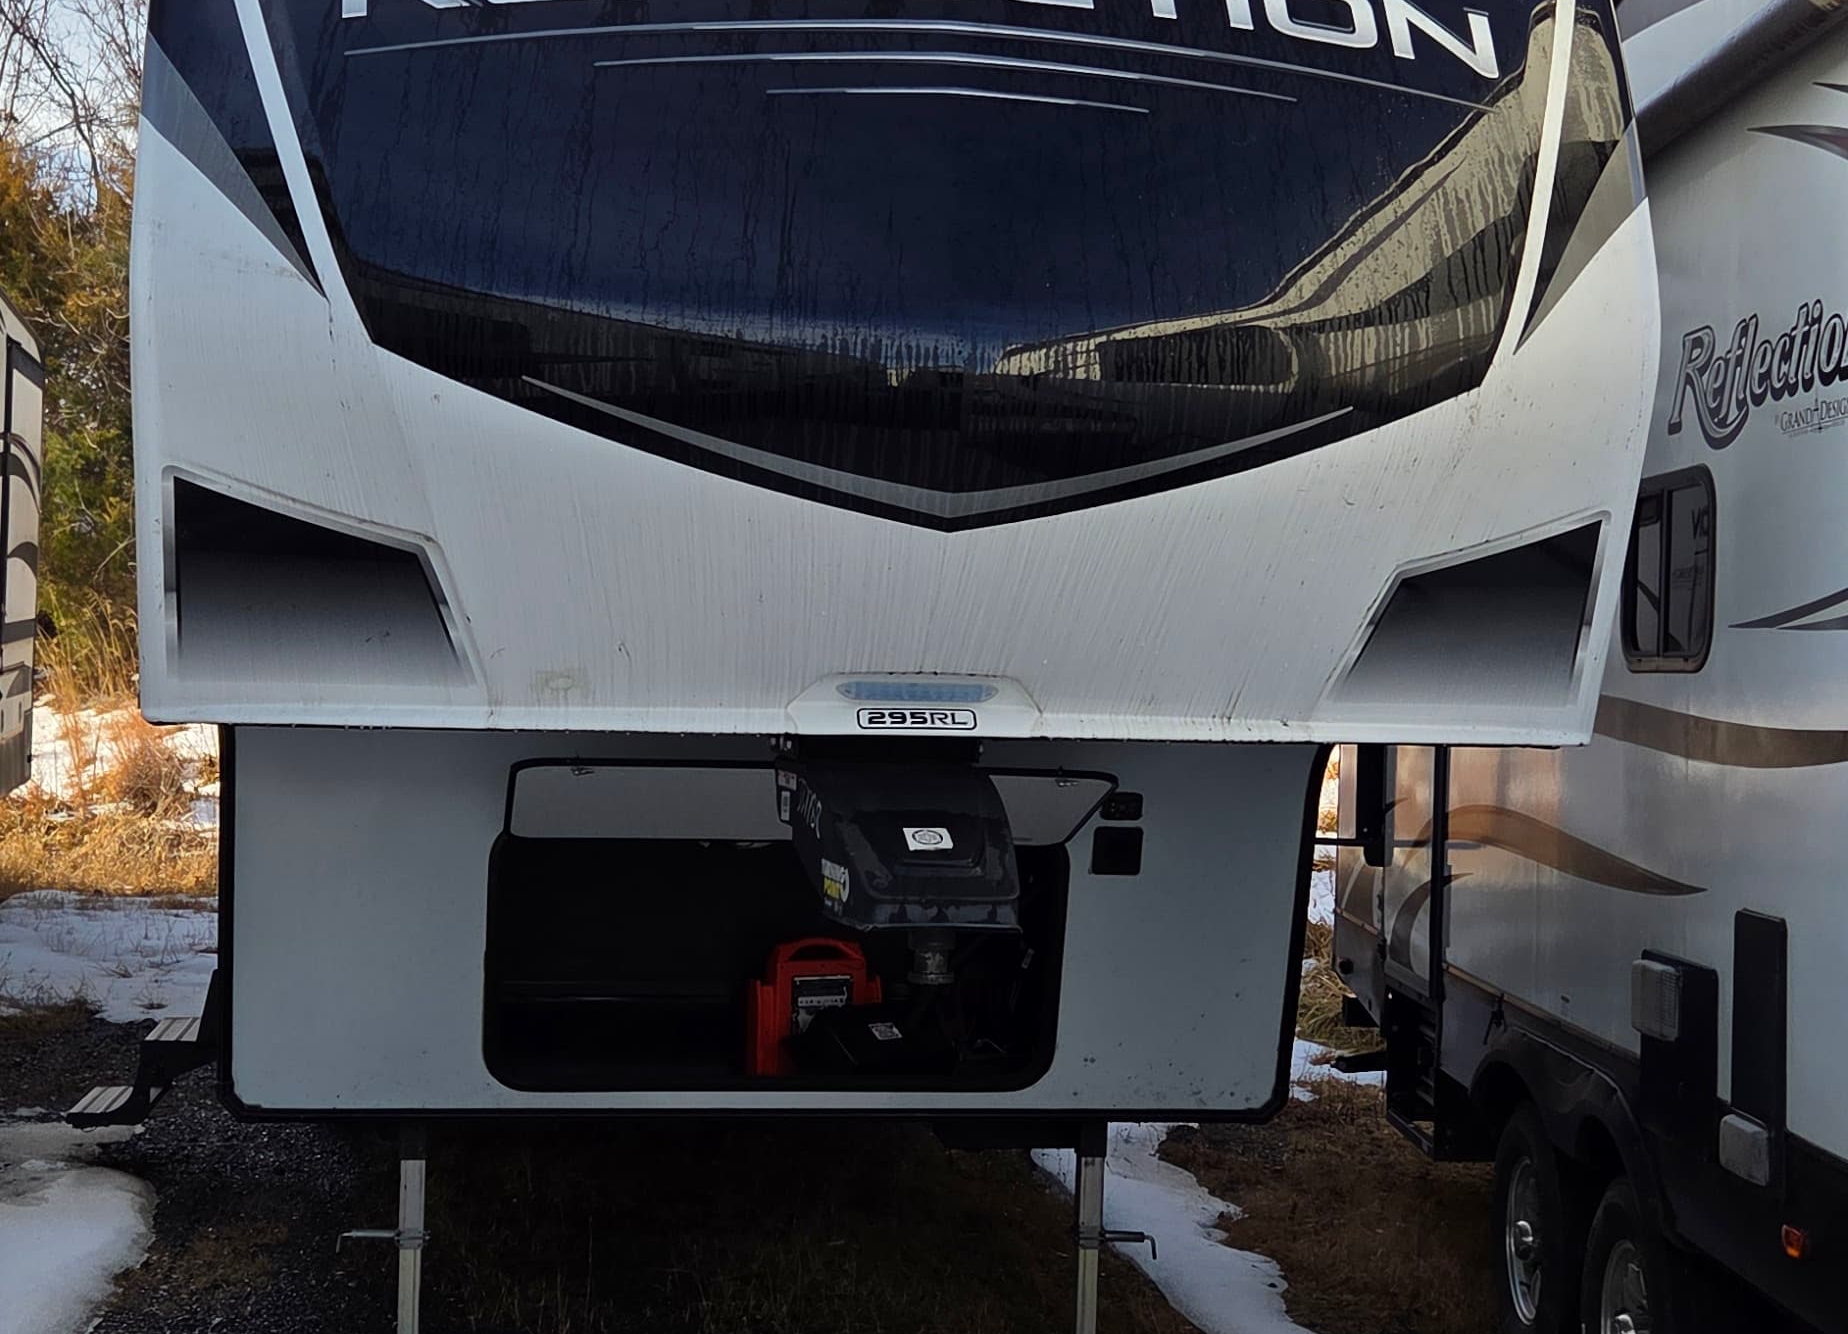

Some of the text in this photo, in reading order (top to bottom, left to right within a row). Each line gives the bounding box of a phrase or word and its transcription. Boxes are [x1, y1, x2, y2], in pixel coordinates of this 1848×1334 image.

[1780, 407, 1814, 432] GRAND
[1820, 398, 1848, 421] DESIG
[867, 711, 969, 725] 295RL
